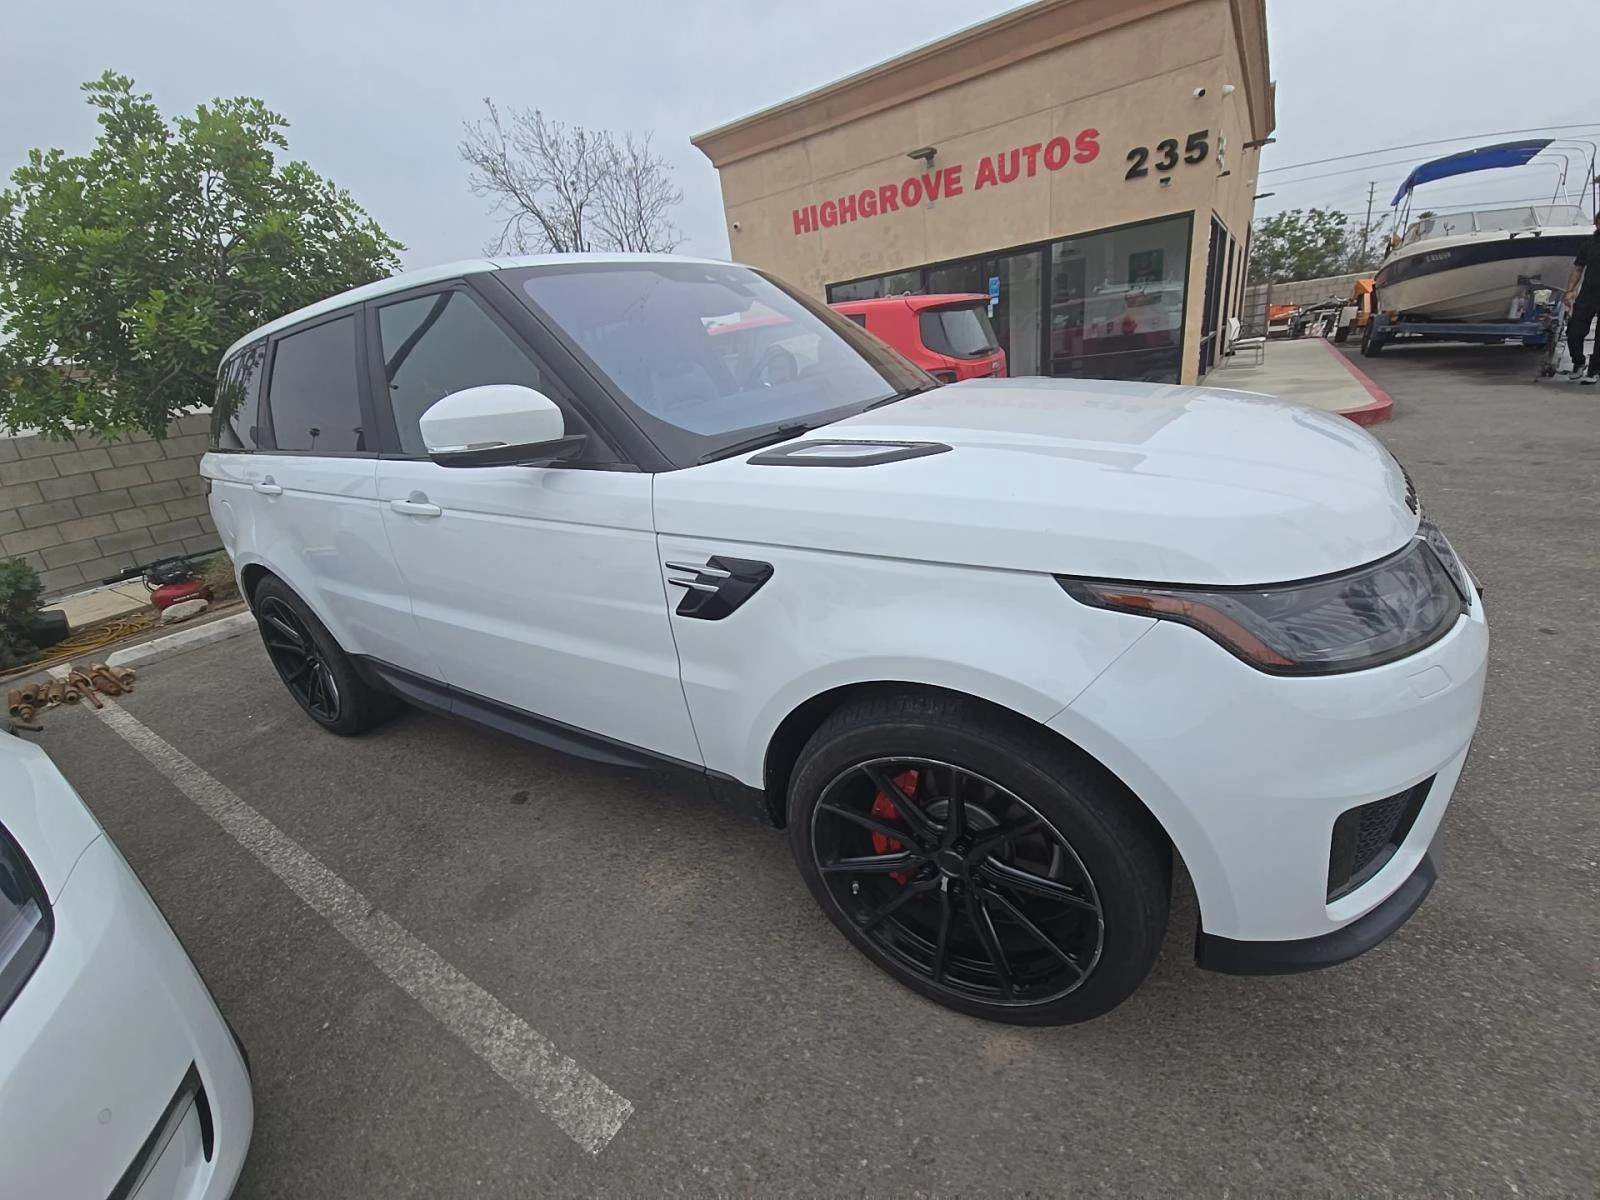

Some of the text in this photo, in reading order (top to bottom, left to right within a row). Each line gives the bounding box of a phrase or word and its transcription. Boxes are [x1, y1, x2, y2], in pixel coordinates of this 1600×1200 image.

[793, 128, 1100, 235] HIGHGROVE AUTOS
[1125, 129, 1209, 181] 235
